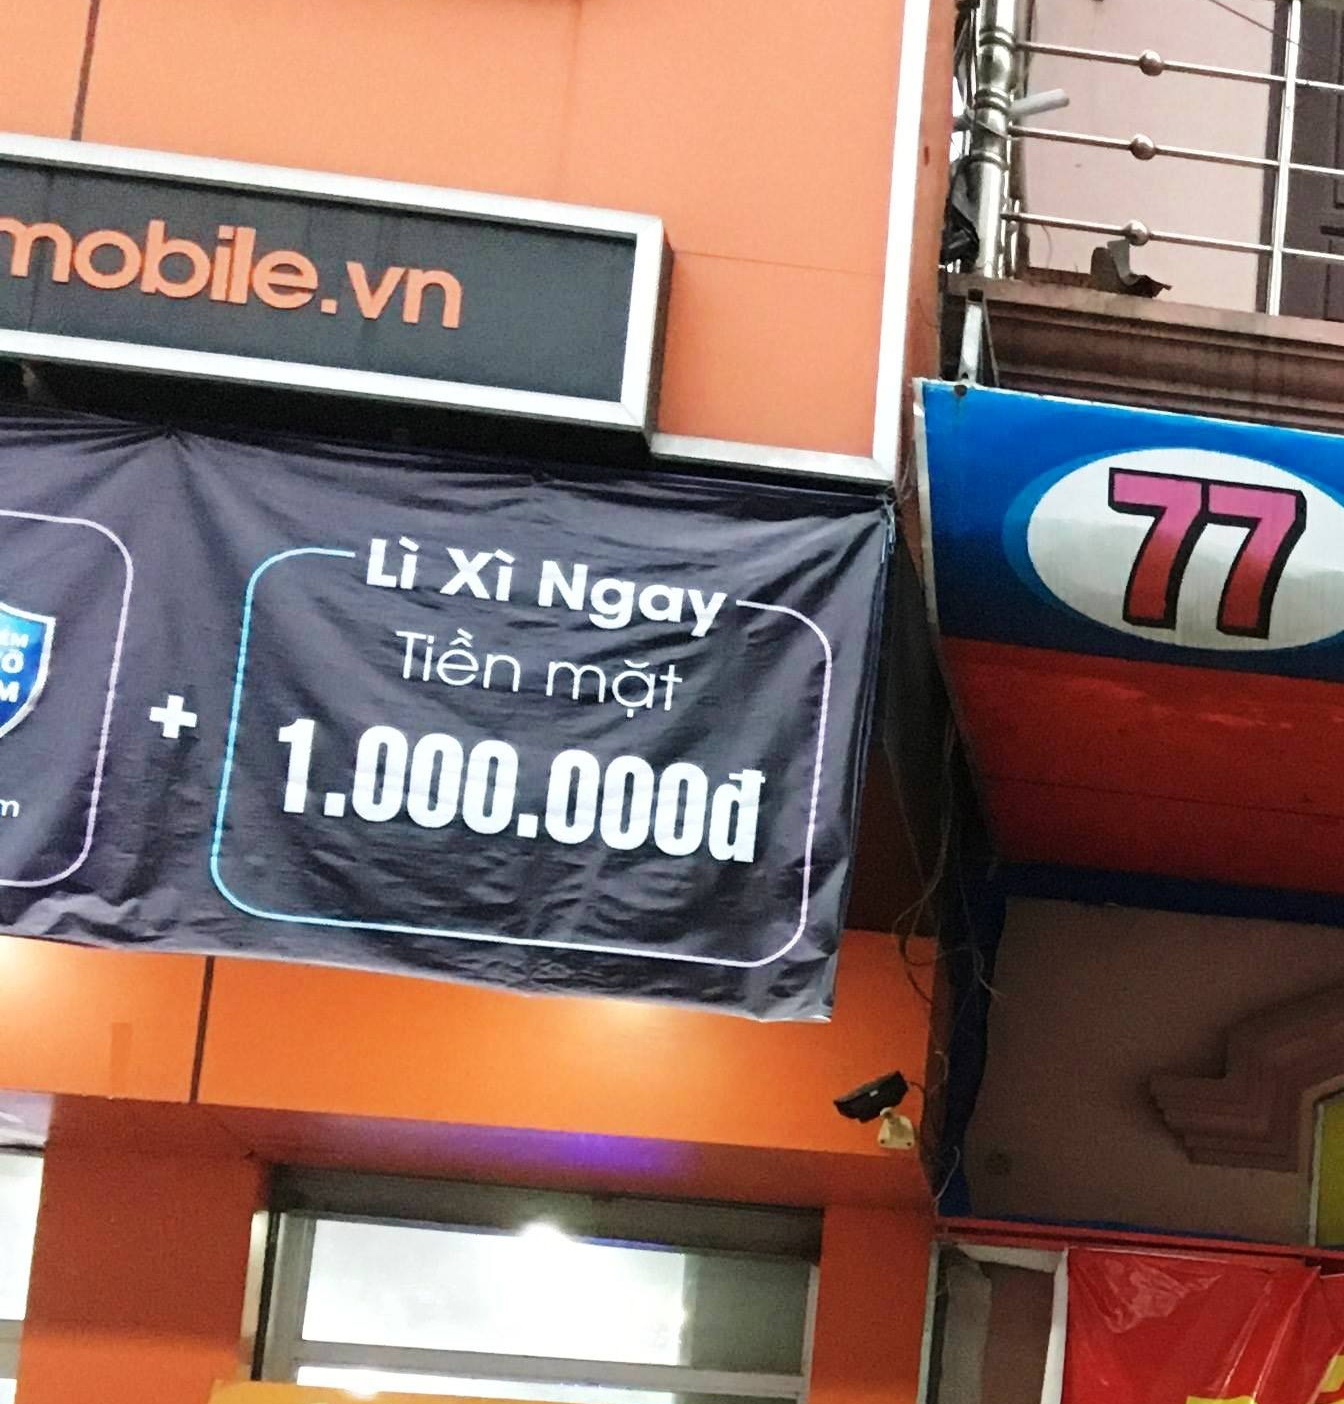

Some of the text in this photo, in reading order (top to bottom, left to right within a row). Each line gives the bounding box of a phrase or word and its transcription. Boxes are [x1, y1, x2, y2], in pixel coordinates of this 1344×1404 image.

[366, 537, 729, 639] Lì Xì Ngay
[1107, 466, 1308, 640] 77
[395, 630, 685, 721] Tiền mặt
[278, 717, 768, 864] 1.000.000đ
